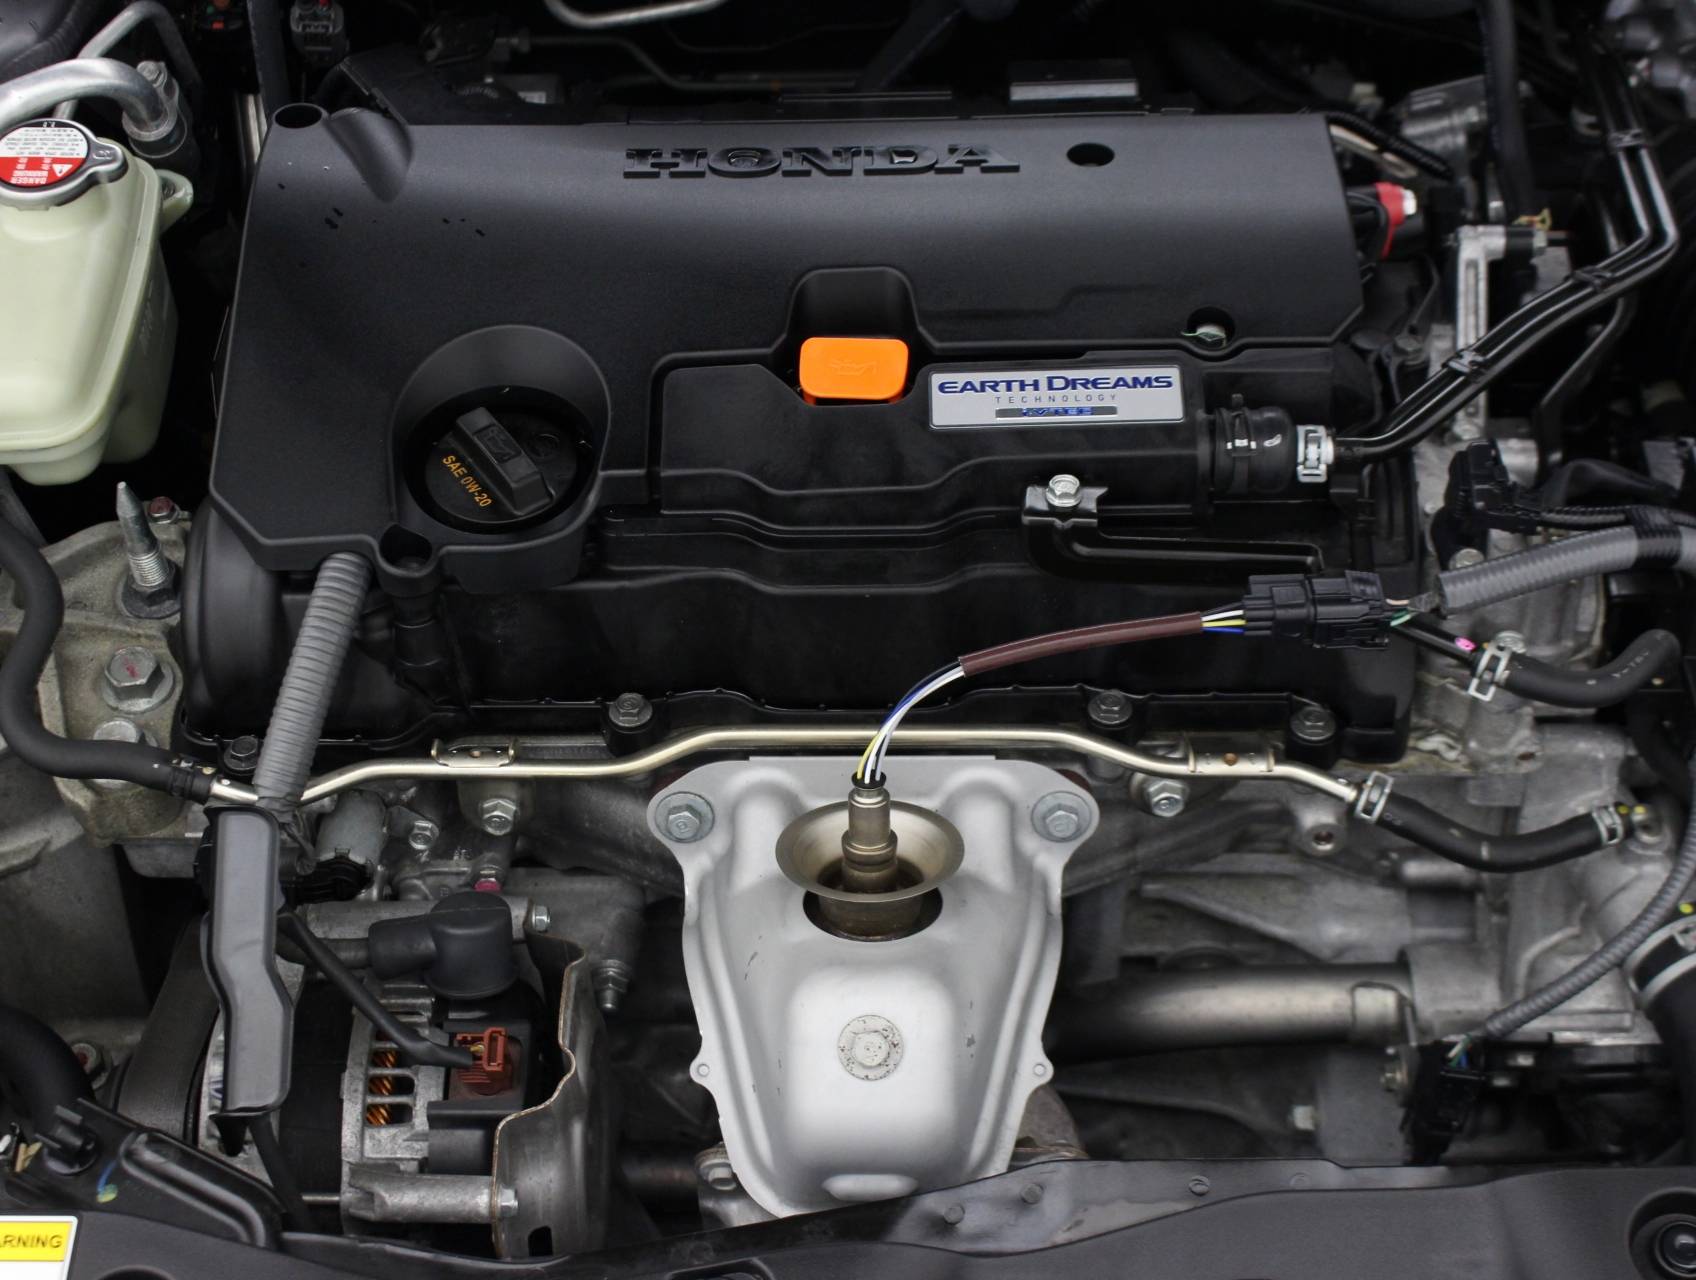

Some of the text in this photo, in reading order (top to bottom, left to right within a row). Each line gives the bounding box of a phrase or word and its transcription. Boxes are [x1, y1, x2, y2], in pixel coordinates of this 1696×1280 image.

[623, 144, 1020, 178] HONDA
[938, 376, 1173, 394] EARTH DREAMS
[995, 395, 1116, 404] TECHNOLOGY
[442, 455, 492, 507] SAE 0W-20
[0, 1234, 63, 1248] RNING
